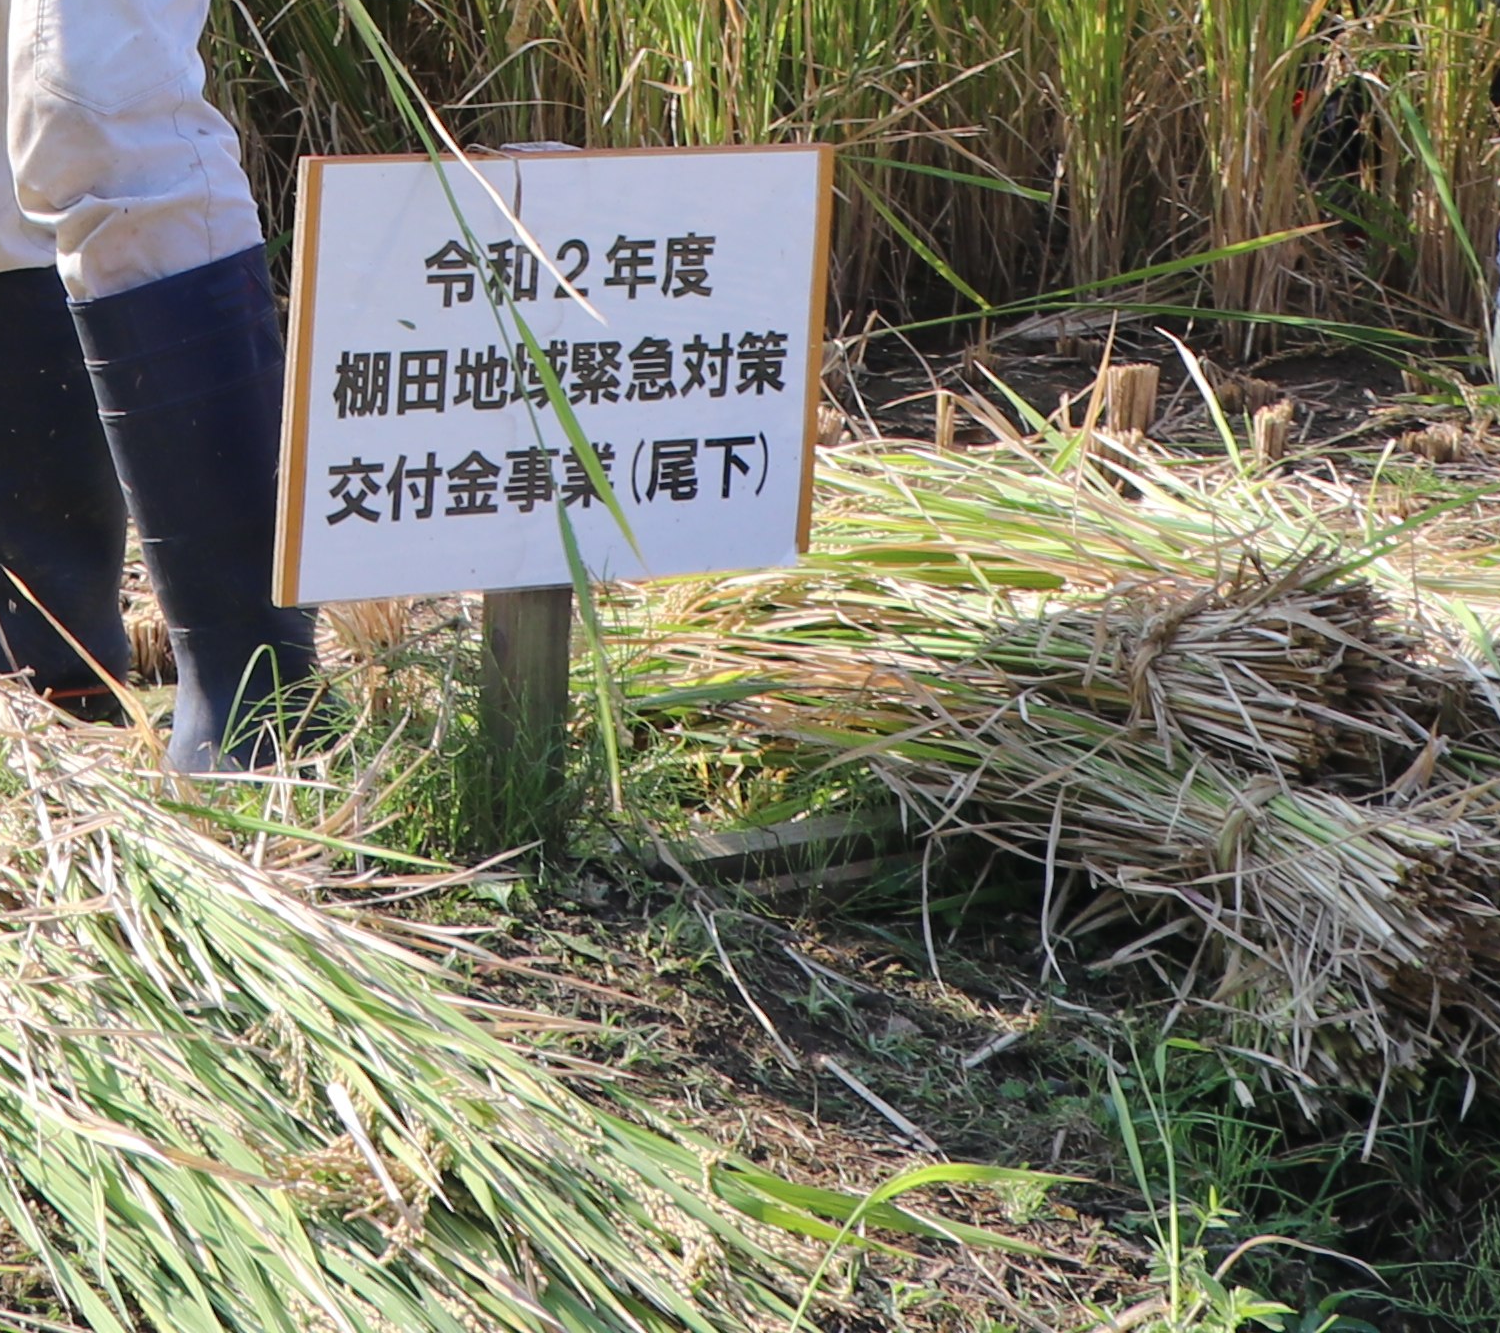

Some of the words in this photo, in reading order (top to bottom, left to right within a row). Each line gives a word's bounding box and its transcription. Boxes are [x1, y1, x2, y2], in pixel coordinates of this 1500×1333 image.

[424, 233, 717, 308] 令和2年度
[333, 331, 789, 419] 棚田地域緊急対策
[325, 431, 770, 525] 交付金事業(尾下)
